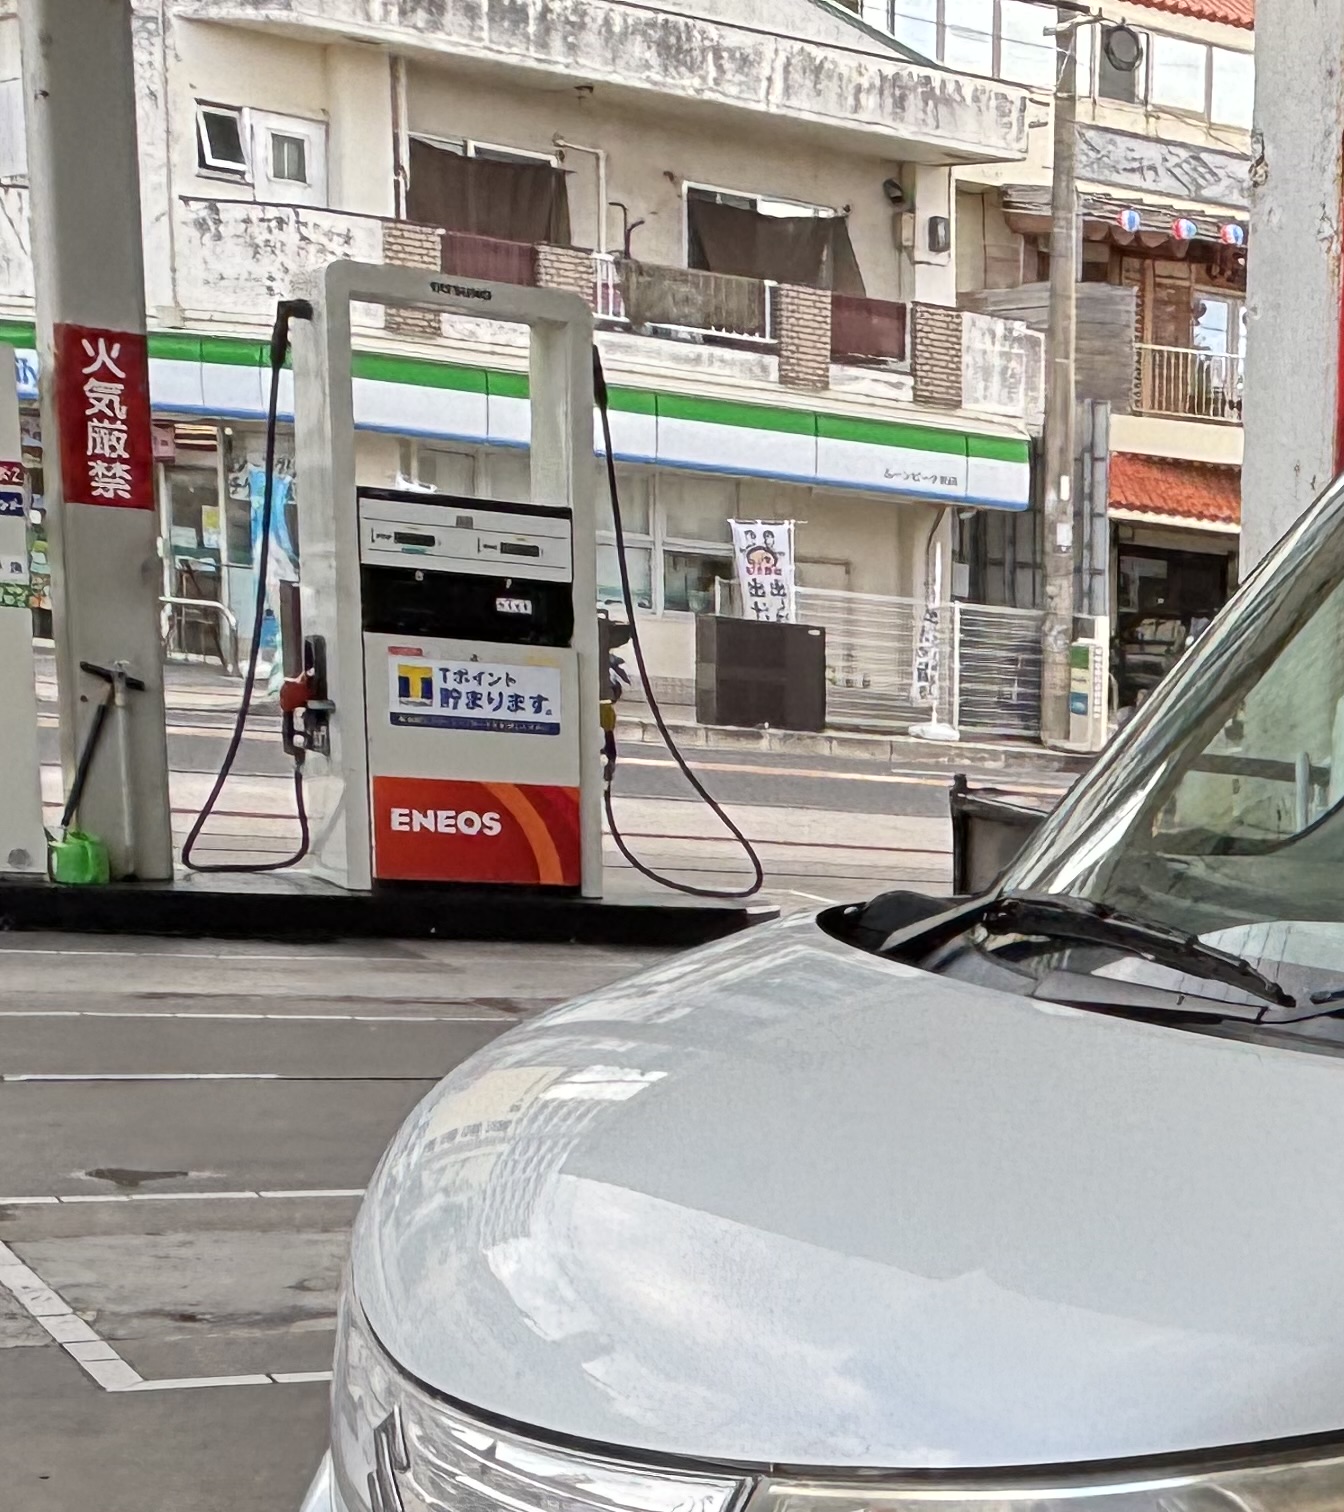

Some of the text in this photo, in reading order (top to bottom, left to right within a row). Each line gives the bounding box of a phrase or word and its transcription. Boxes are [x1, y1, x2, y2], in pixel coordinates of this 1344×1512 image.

[81, 338, 132, 499] 火気厳禁
[439, 667, 517, 688] Tポイント
[440, 687, 553, 716] 貯まります。
[390, 807, 503, 837] ENEOS
